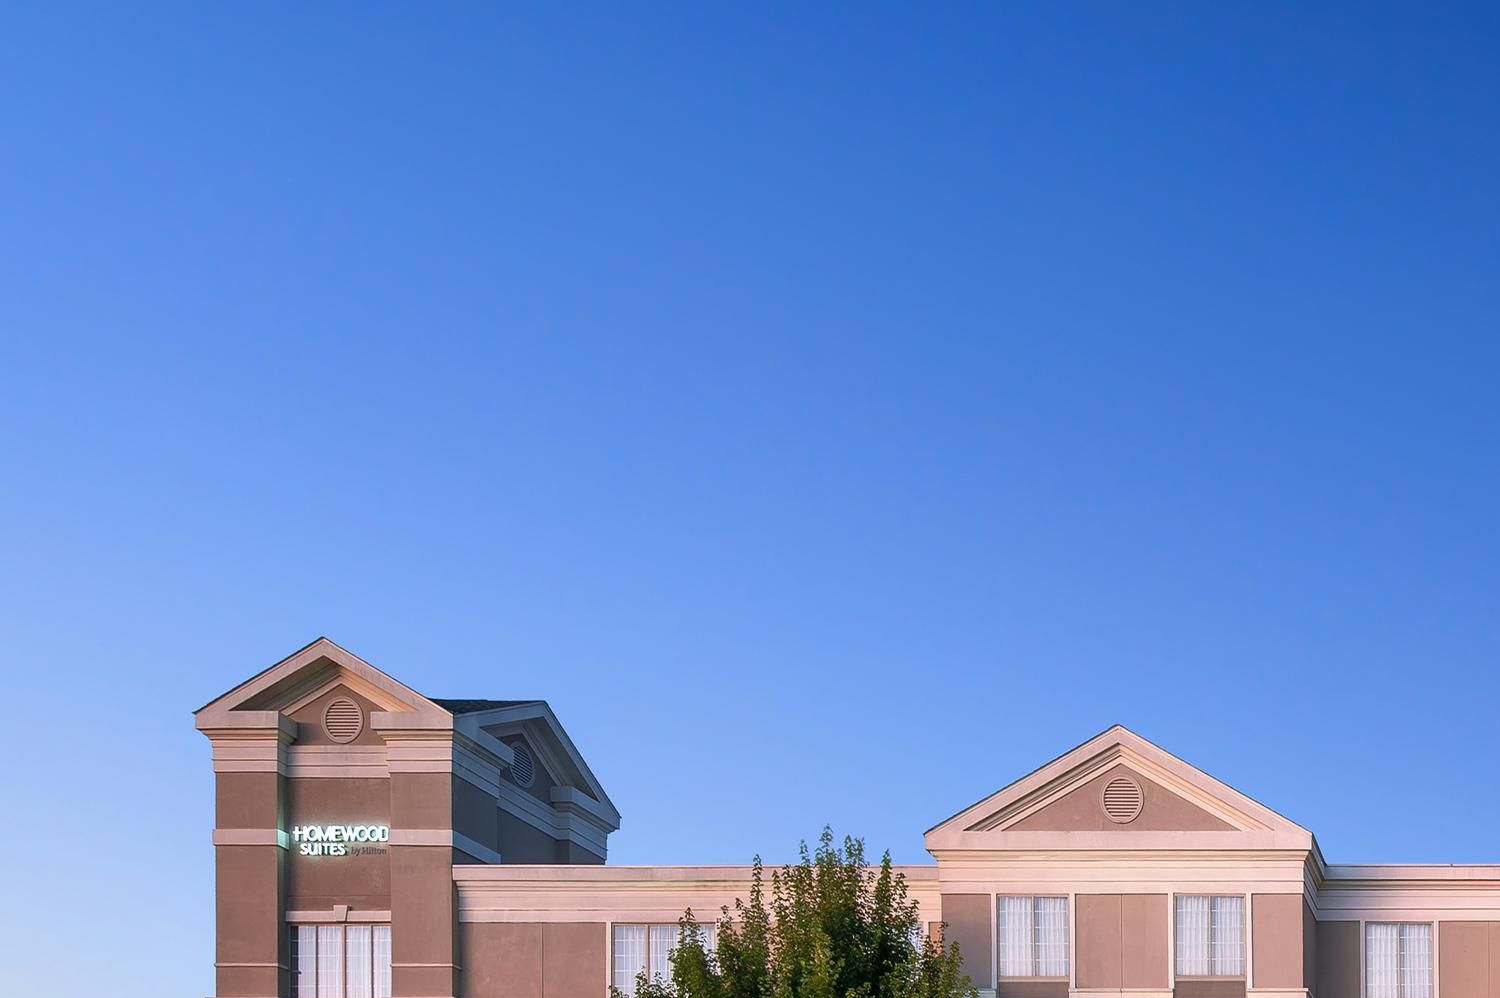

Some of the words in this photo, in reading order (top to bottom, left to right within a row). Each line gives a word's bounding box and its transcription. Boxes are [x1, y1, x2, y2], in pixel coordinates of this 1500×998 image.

[293, 825, 389, 842] HOMEWOOD
[300, 843, 346, 856] SUITES
[351, 846, 360, 856] by
[361, 846, 387, 855] Hilton
